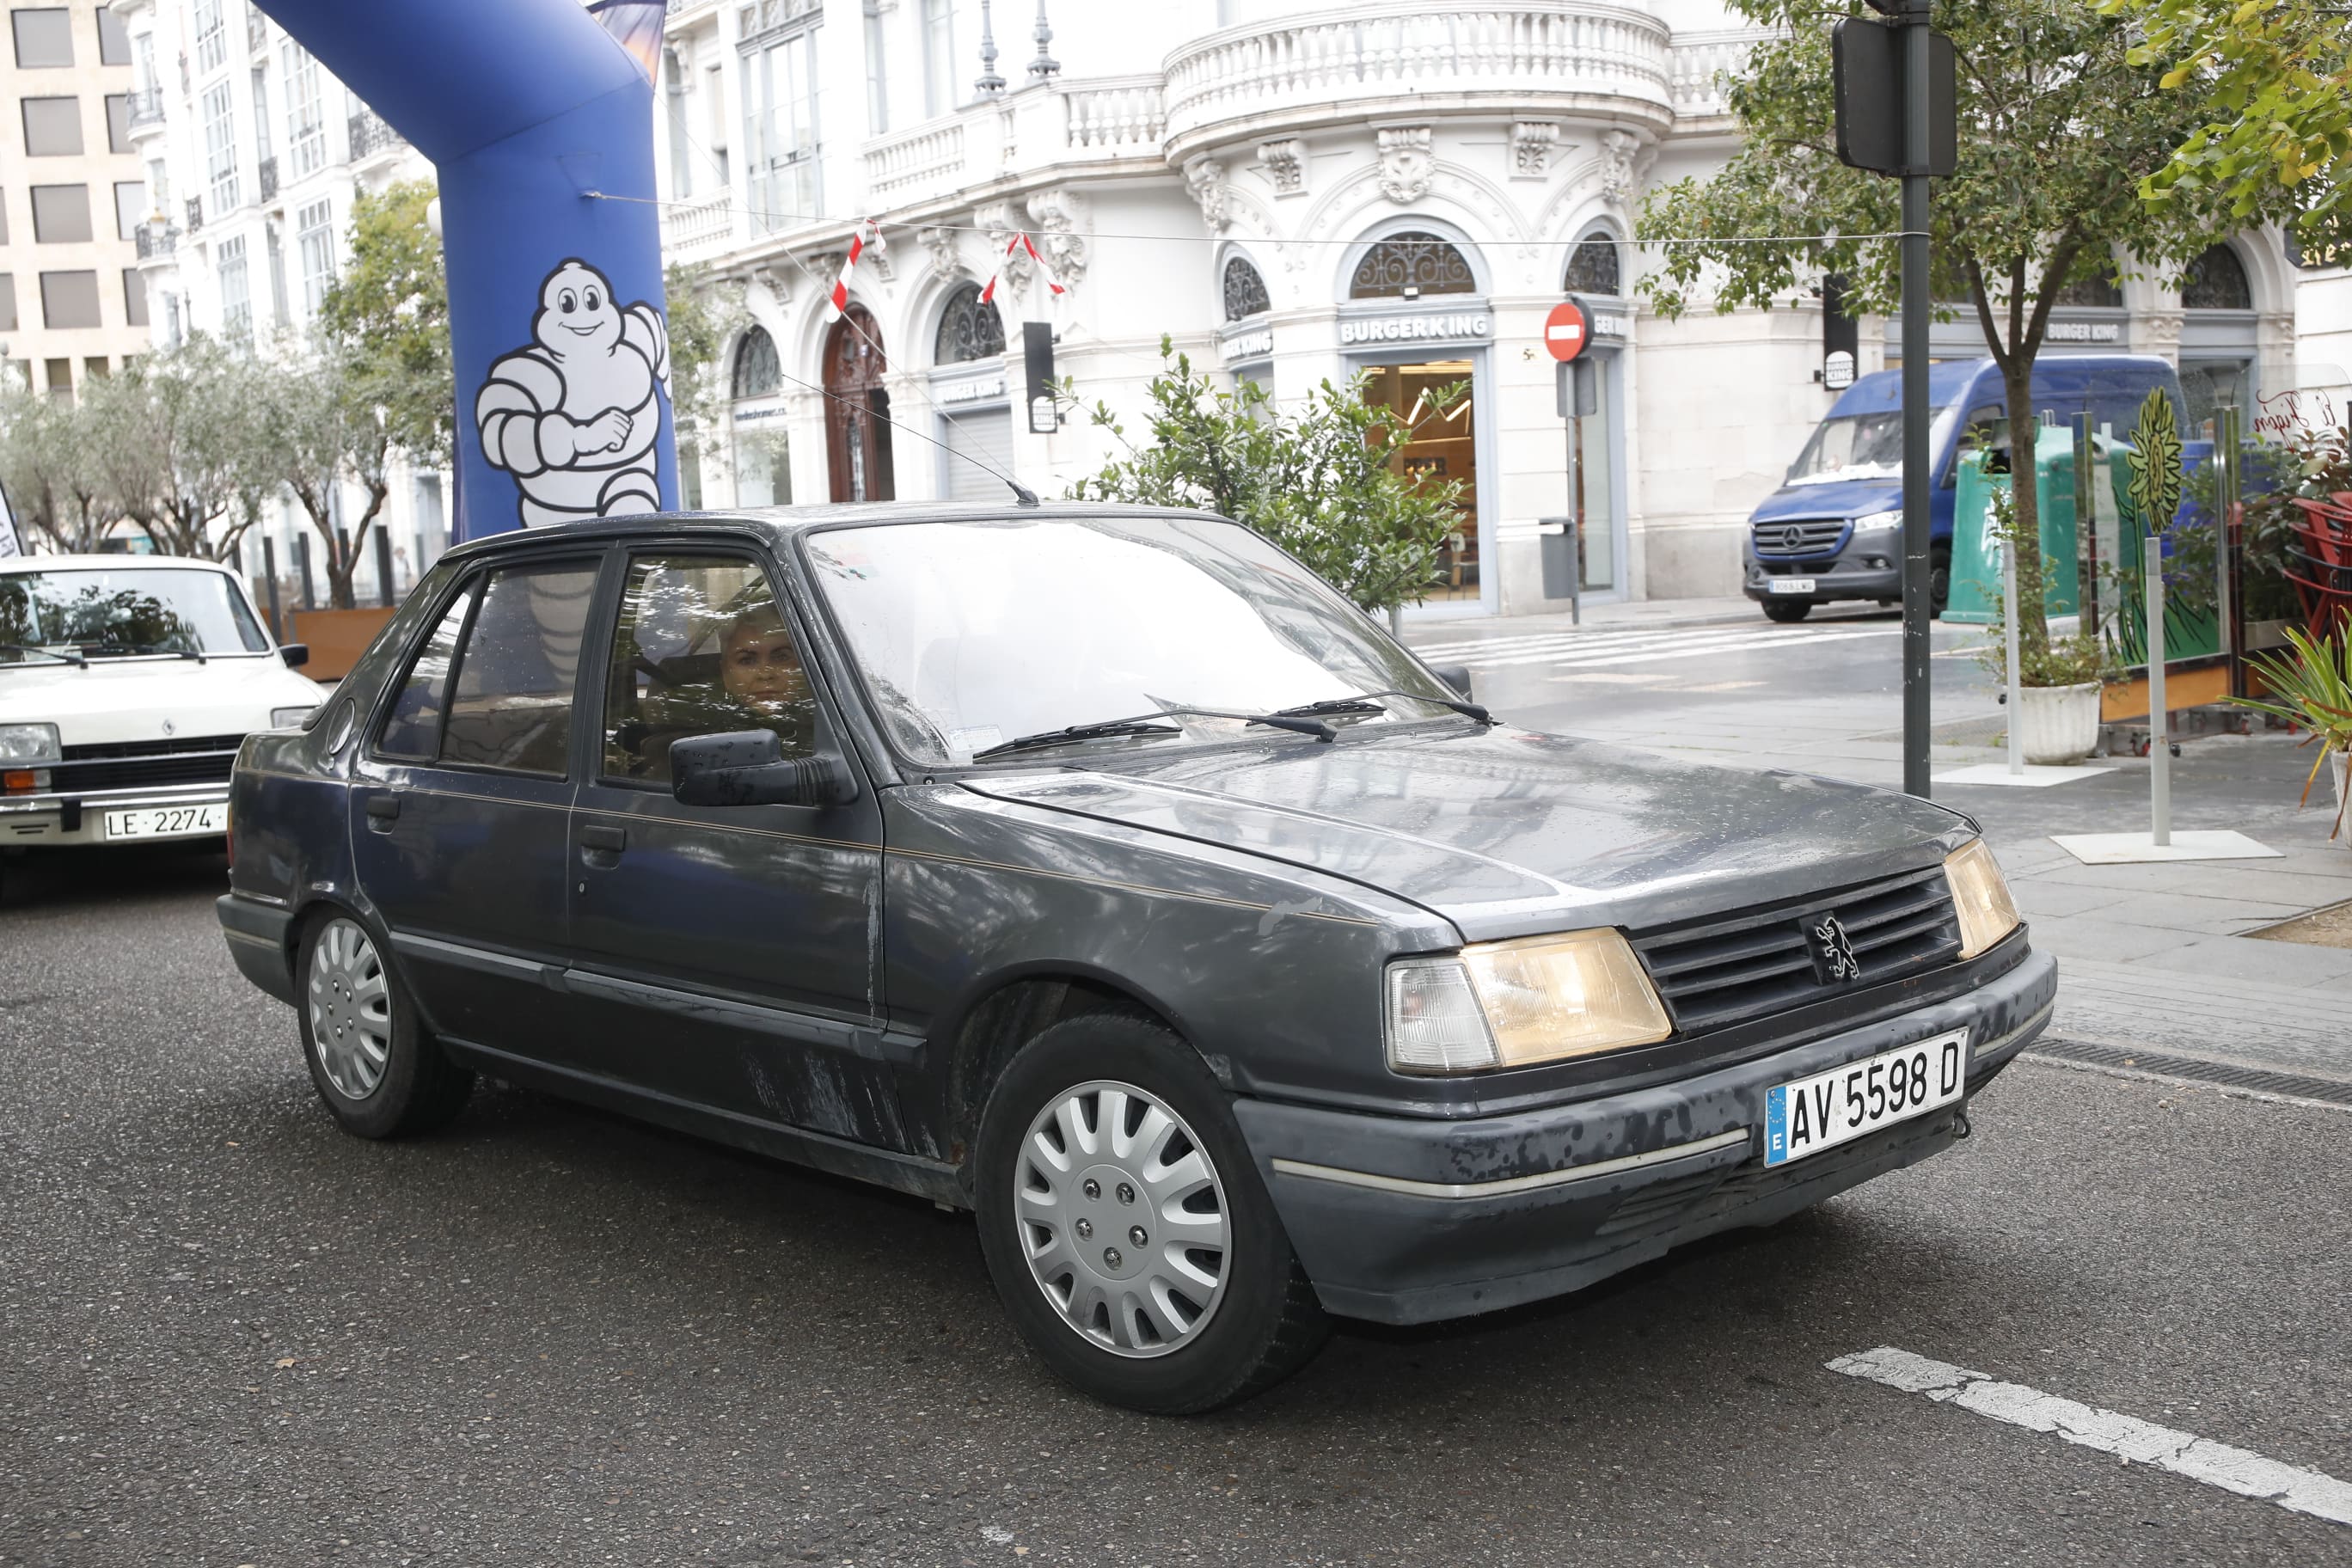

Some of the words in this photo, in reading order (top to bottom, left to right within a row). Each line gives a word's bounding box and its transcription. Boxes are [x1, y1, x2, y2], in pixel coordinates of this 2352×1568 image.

[1341, 317, 1427, 342] BURGER
[1429, 315, 1486, 337] KING
[2048, 323, 2091, 340] BURGER
[2092, 324, 2118, 340] KING
[1240, 332, 1271, 355] KING
[1826, 370, 1853, 381] KING
[1033, 414, 1056, 425] KING
[108, 813, 138, 836] LE
[155, 808, 211, 832] 2274
[1791, 1080, 1834, 1149] AV
[1847, 1051, 1927, 1128] 5598
[1940, 1041, 1959, 1097] D
[1773, 1133, 1782, 1150] E
